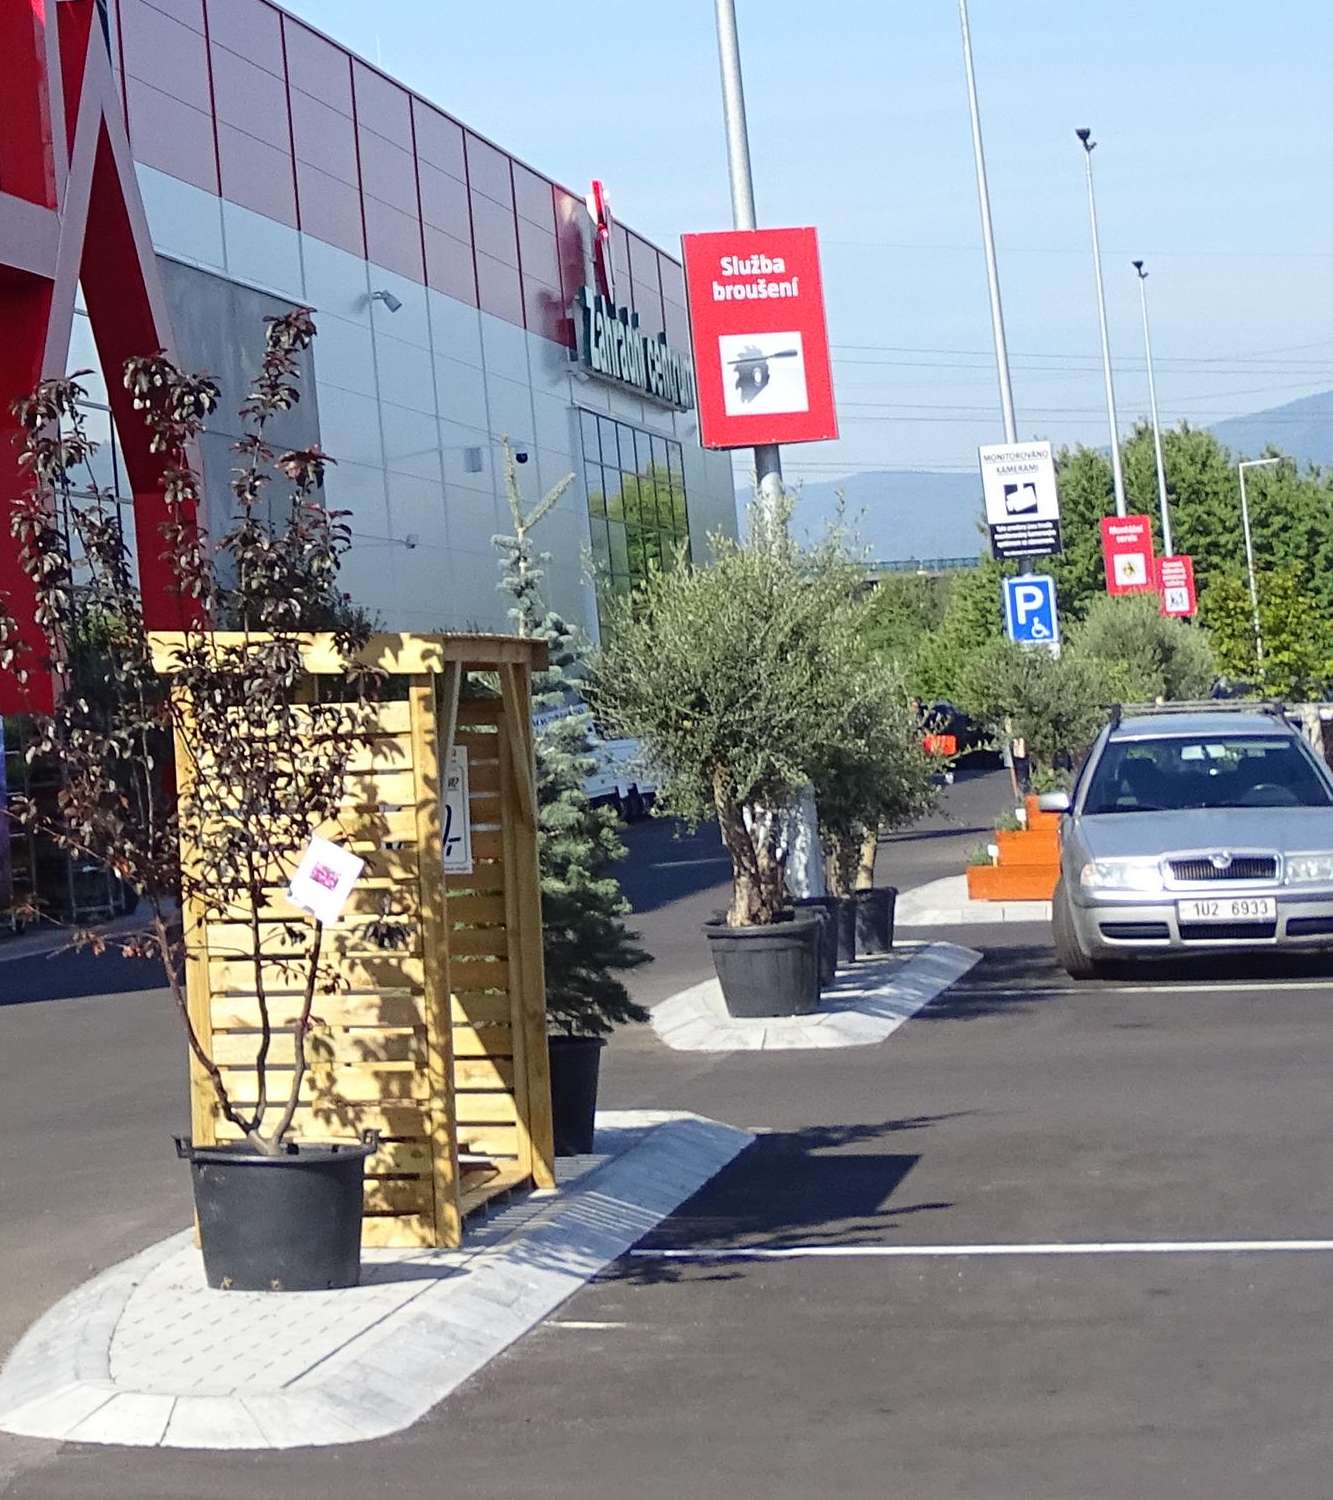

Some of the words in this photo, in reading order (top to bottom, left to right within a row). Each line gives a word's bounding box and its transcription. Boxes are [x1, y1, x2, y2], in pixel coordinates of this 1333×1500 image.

[720, 254, 786, 276] Služba
[712, 276, 799, 301] broušení
[1015, 585, 1044, 625] P
[1194, 902, 1219, 916] 1U2
